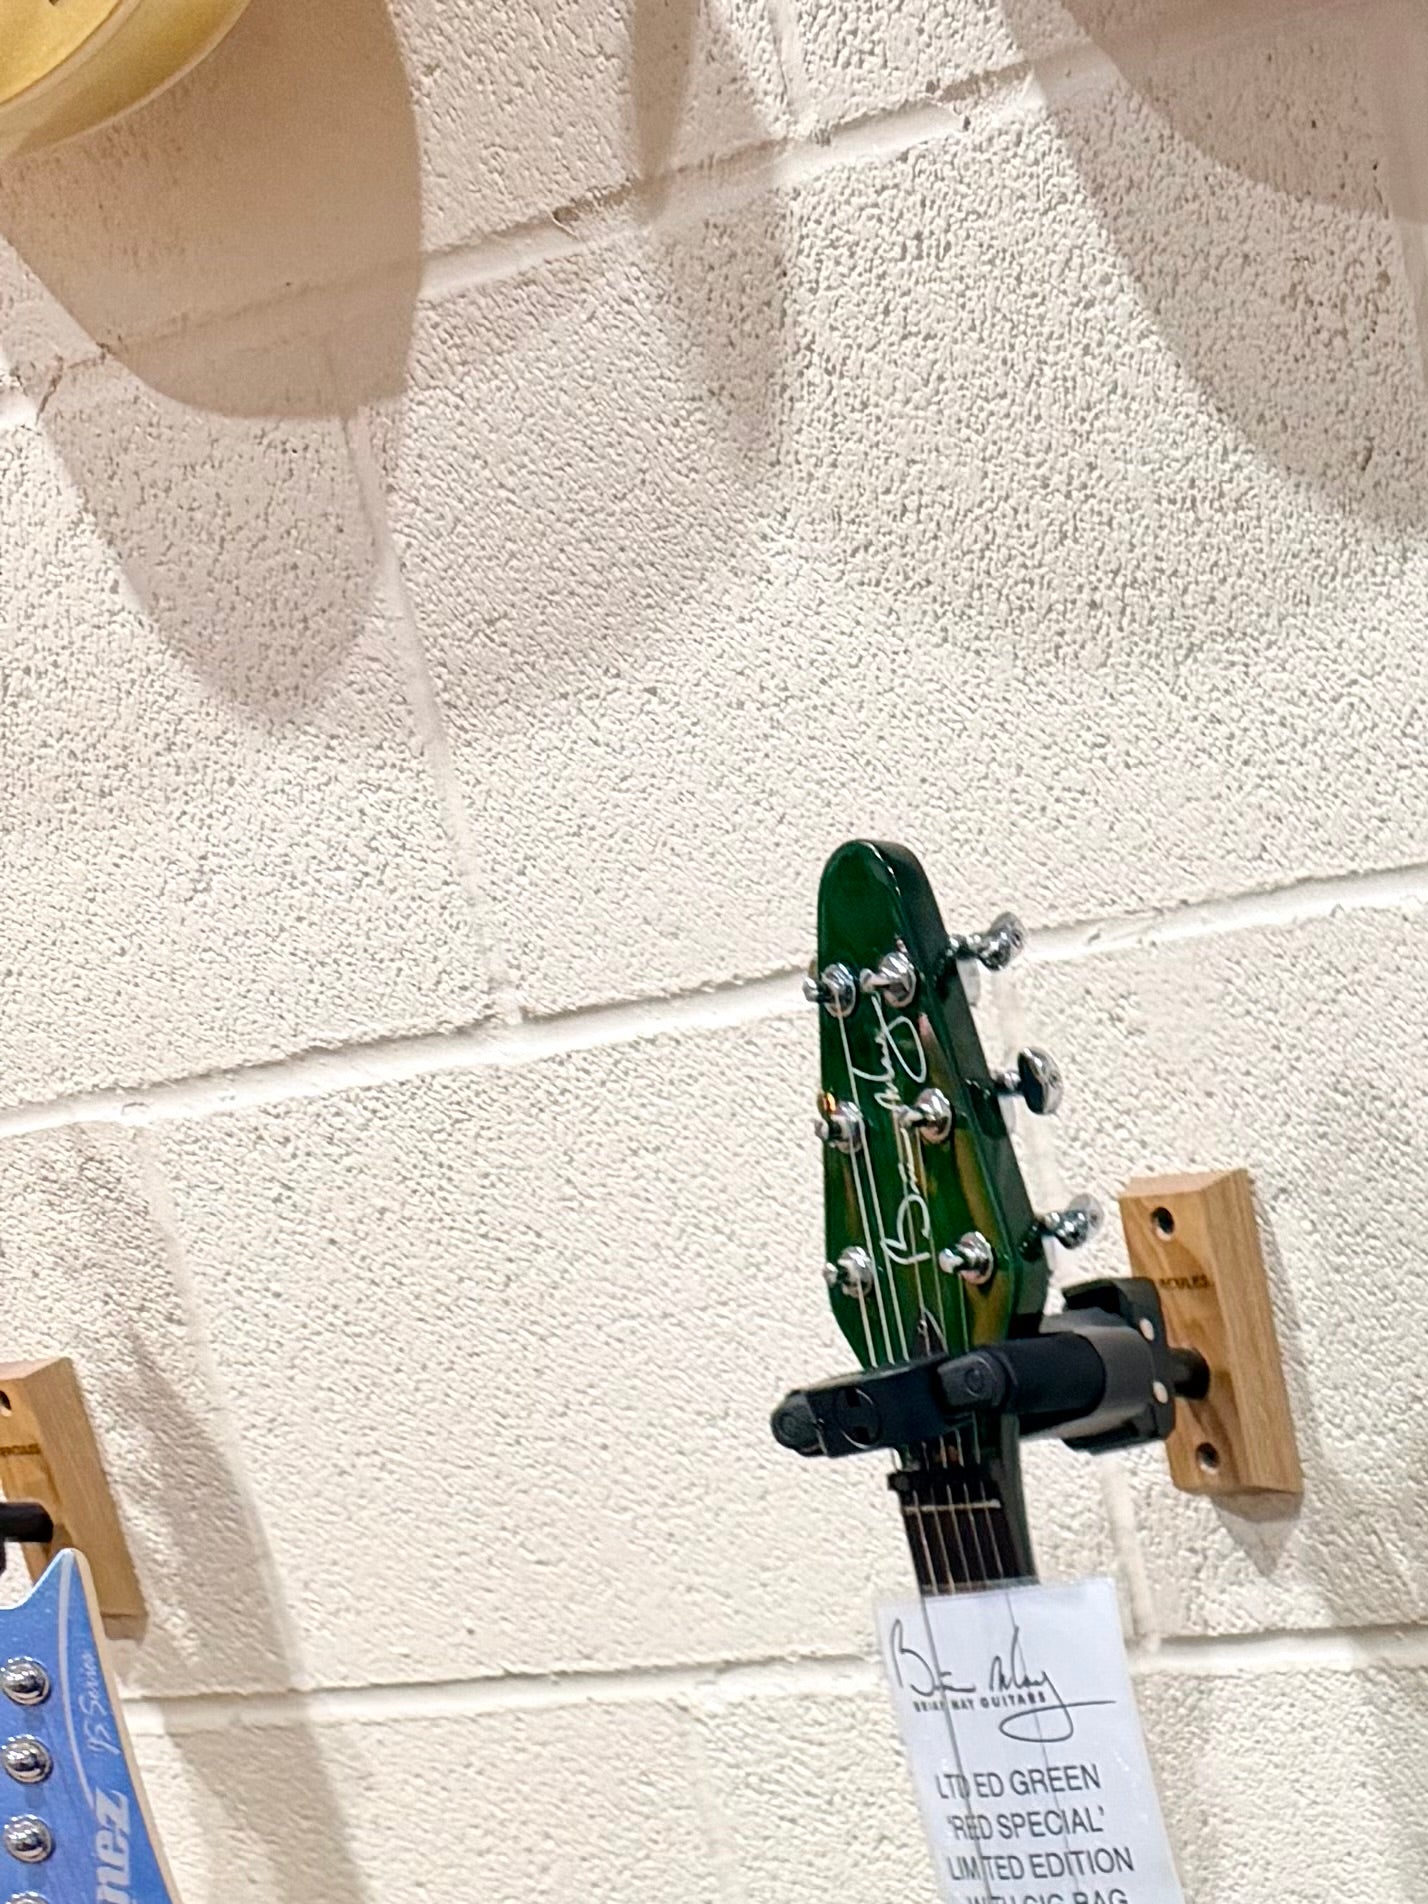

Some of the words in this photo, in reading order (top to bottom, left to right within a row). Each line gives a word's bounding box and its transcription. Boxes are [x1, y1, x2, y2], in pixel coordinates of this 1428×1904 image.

[979, 1691, 1046, 1709] GUITARS
[935, 1772, 971, 1800] LTD
[973, 1771, 1005, 1798] ED
[1009, 1763, 1102, 1796] GREEN
[947, 1853, 1025, 1881] LIMTED
[1029, 1846, 1135, 1880] EDITION
